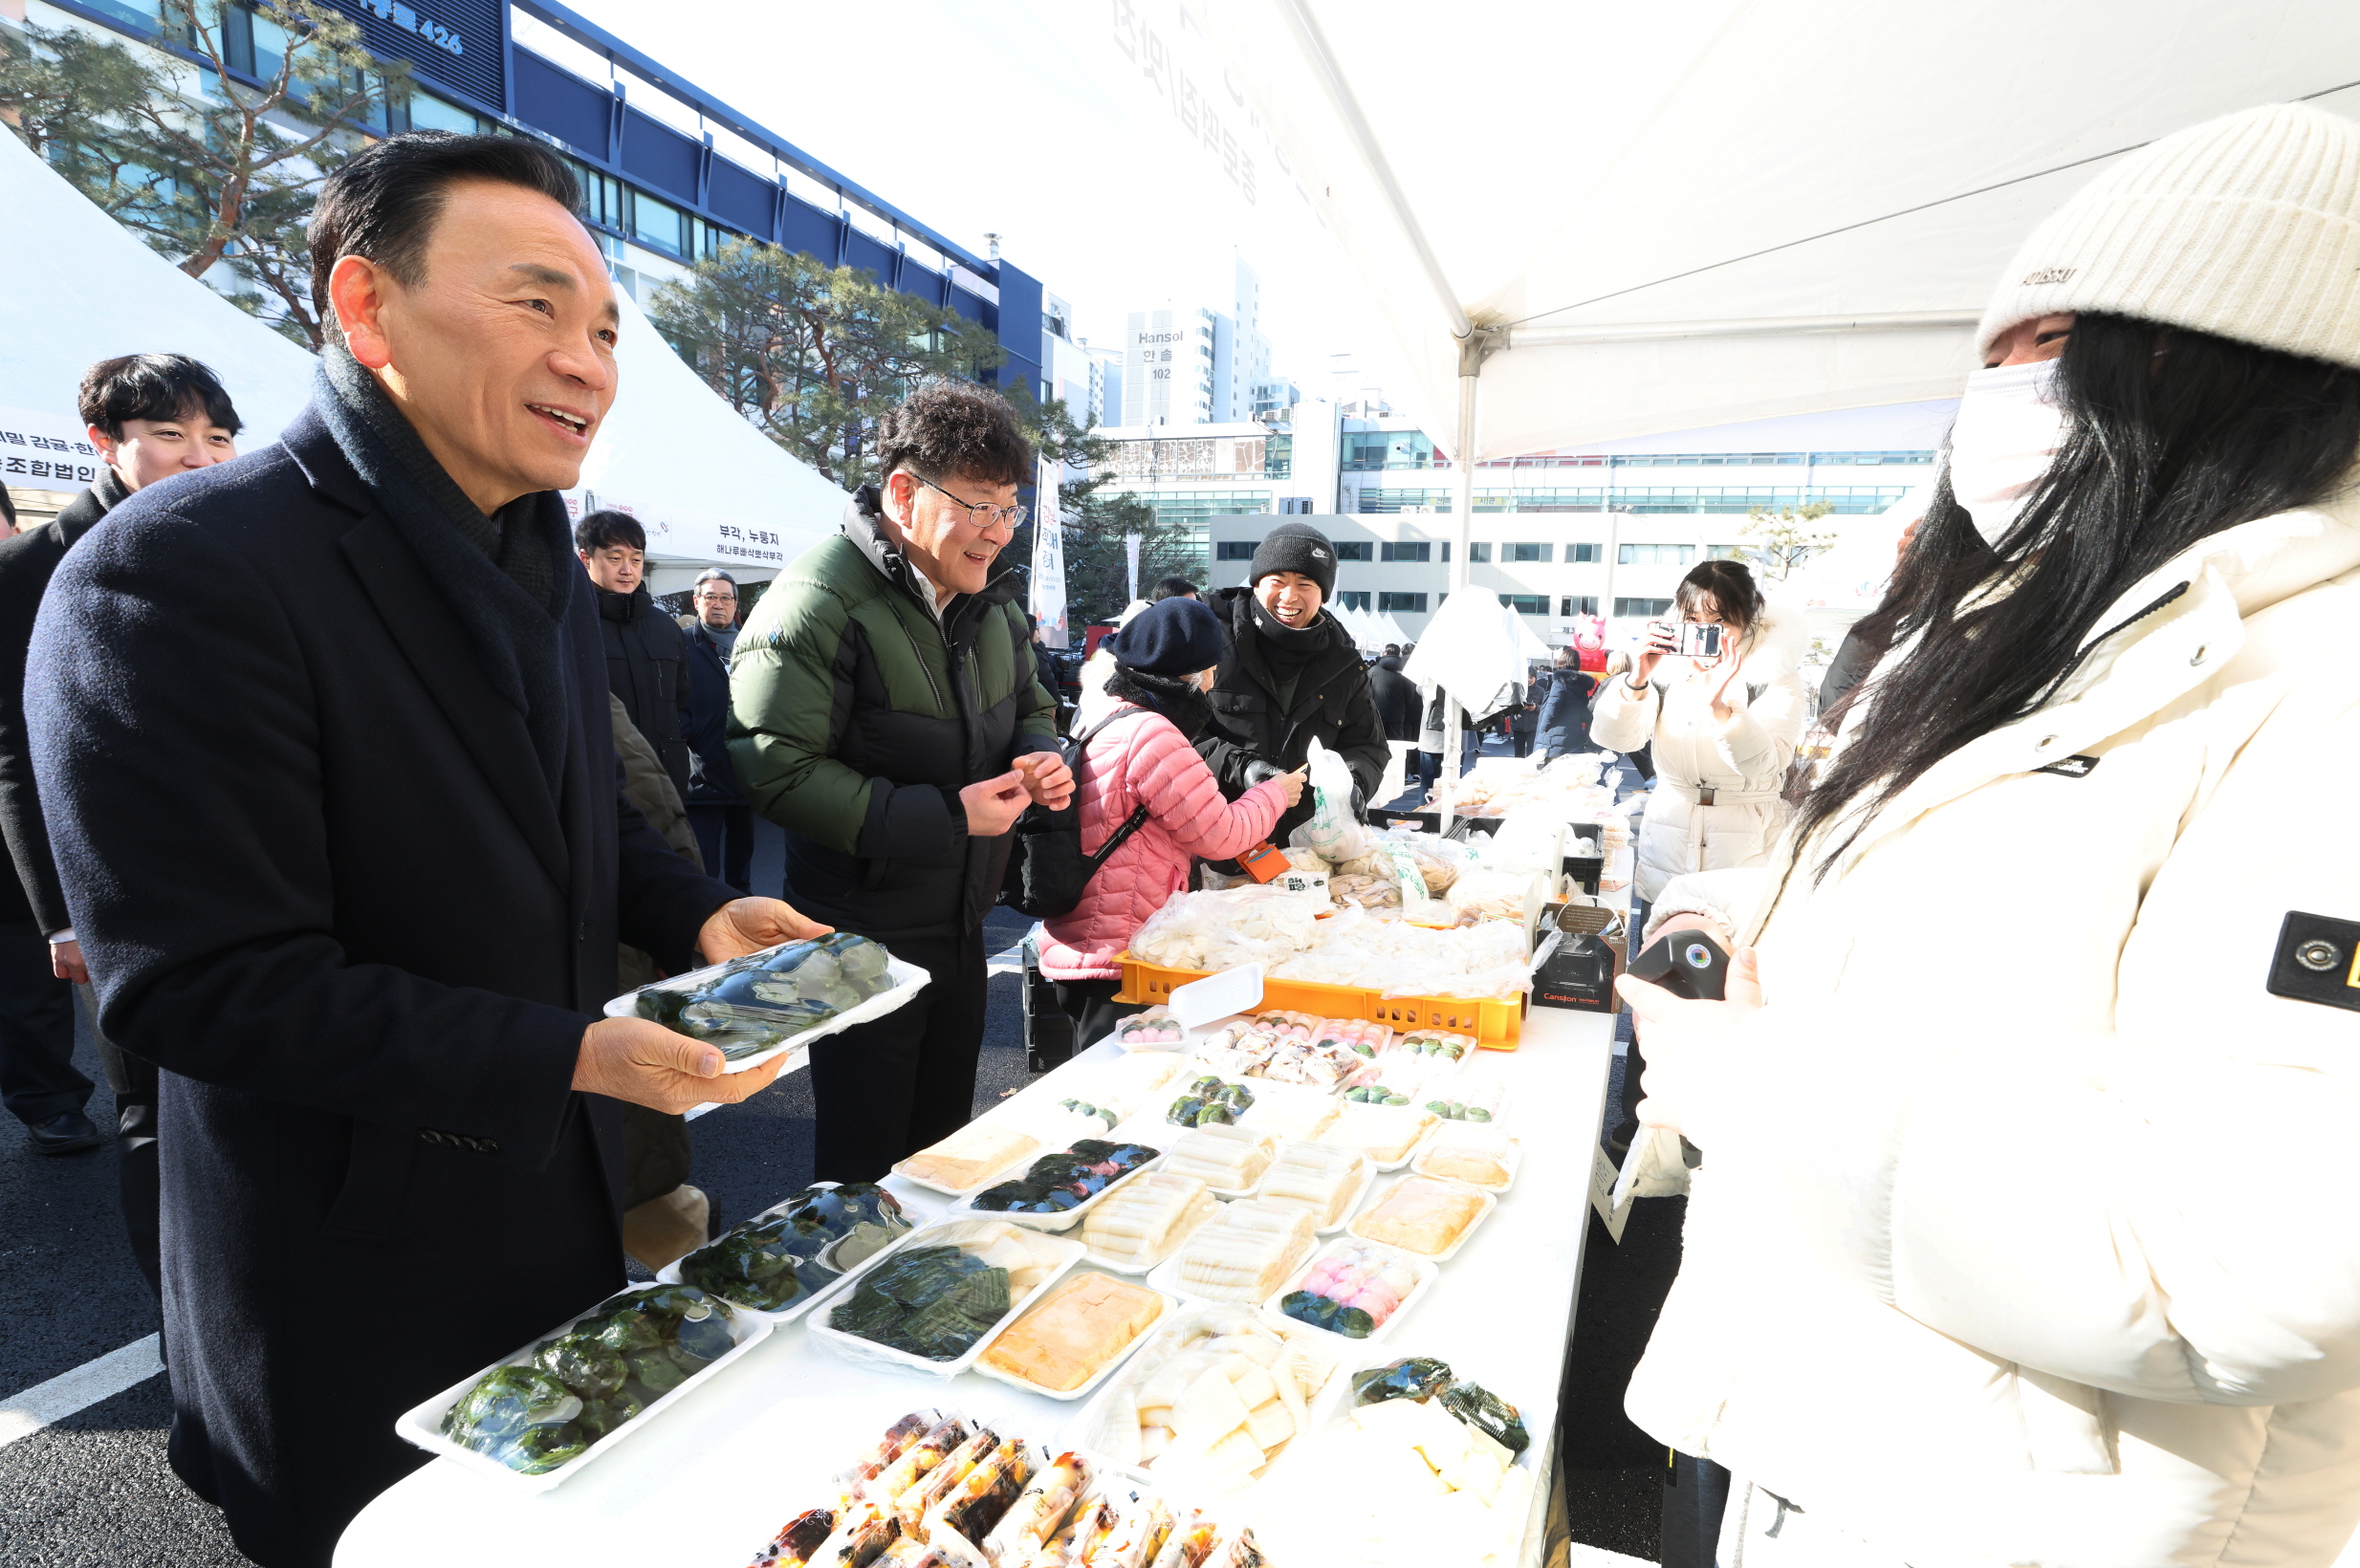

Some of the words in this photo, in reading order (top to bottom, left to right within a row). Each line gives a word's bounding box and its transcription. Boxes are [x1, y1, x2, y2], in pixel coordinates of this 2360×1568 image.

[420, 20, 463, 55] 426
[1138, 330, 1184, 344] Hansol
[1152, 368, 1171, 380] 102
[0, 456, 96, 483] 조합법인
[719, 524, 746, 543] 부각,
[749, 529, 779, 546] 누룽지
[1543, 992, 1577, 1003] Canston
